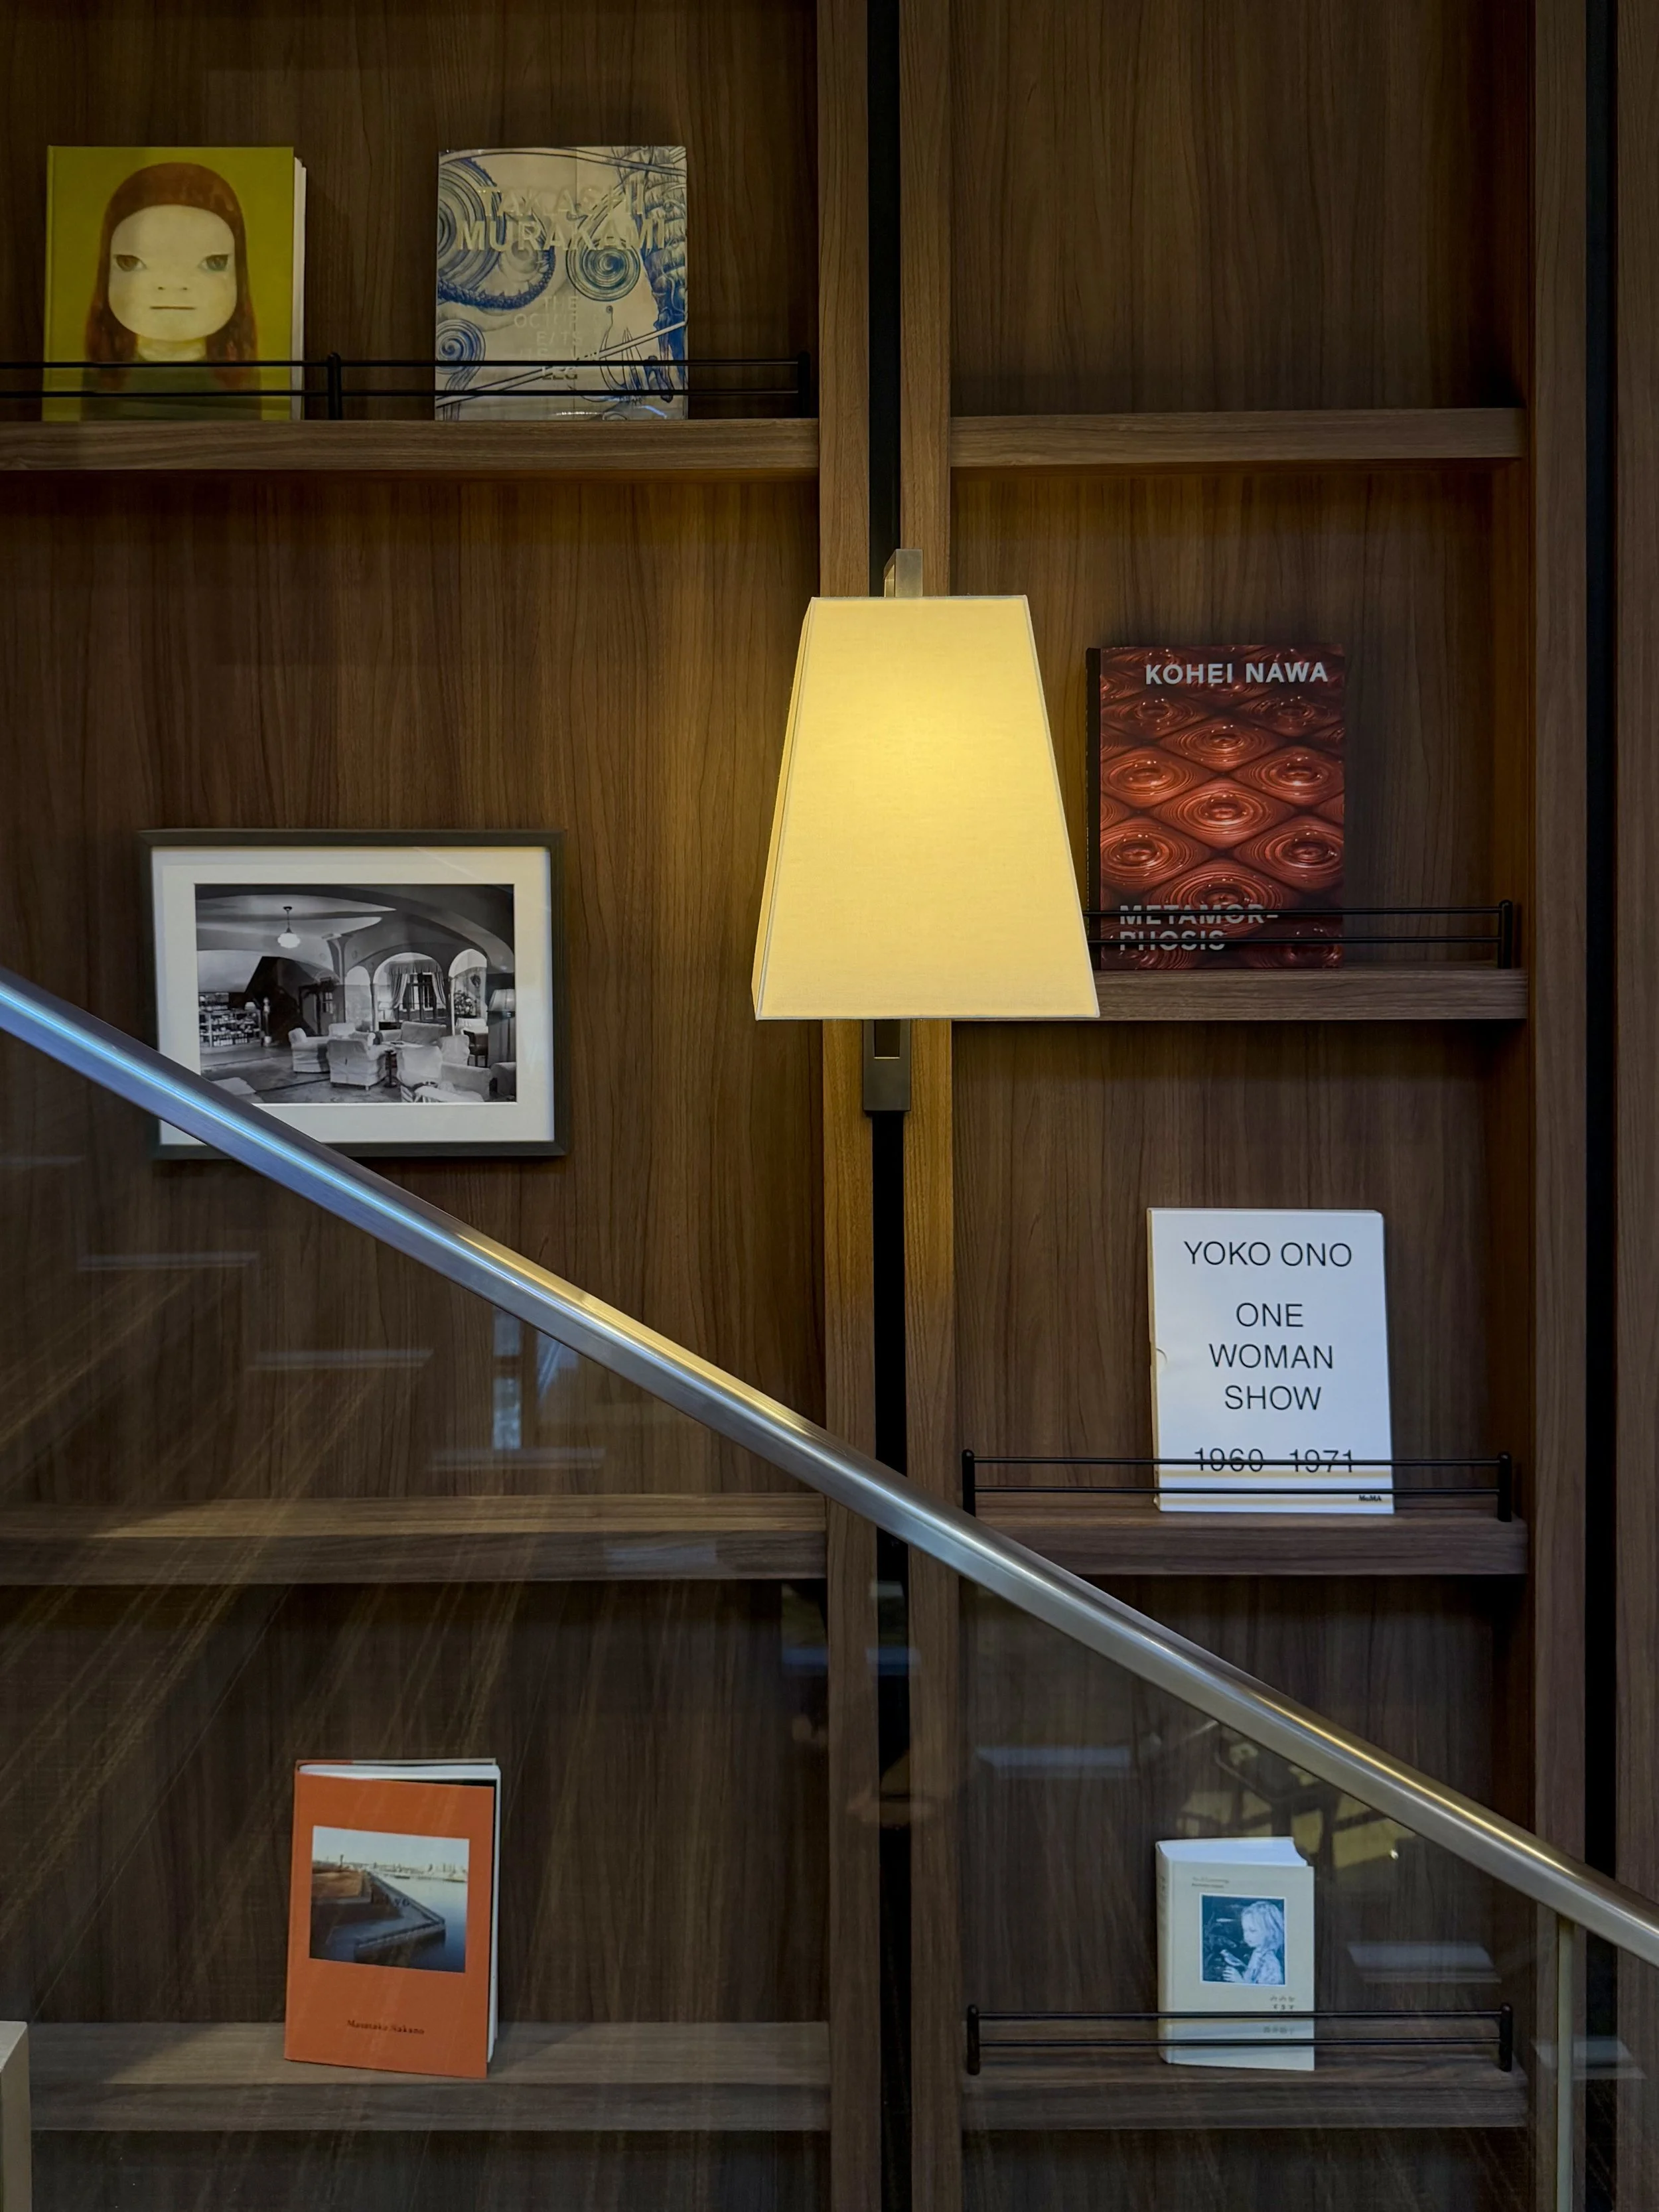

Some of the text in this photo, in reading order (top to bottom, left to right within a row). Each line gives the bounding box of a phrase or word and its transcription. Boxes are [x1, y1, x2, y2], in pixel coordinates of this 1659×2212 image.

[478, 182, 644, 216] TAKASHI
[459, 219, 665, 251] MURAKAMI
[1145, 662, 1328, 685] KOHEI NAWA
[1119, 904, 1279, 925] METAMOR-
[1119, 929, 1226, 951] PHOSIS
[1184, 1241, 1352, 1267] YOKO ONO
[1236, 1302, 1304, 1328] ONE
[1209, 1343, 1334, 1369] WOMAN
[1224, 1385, 1322, 1411] SHOW
